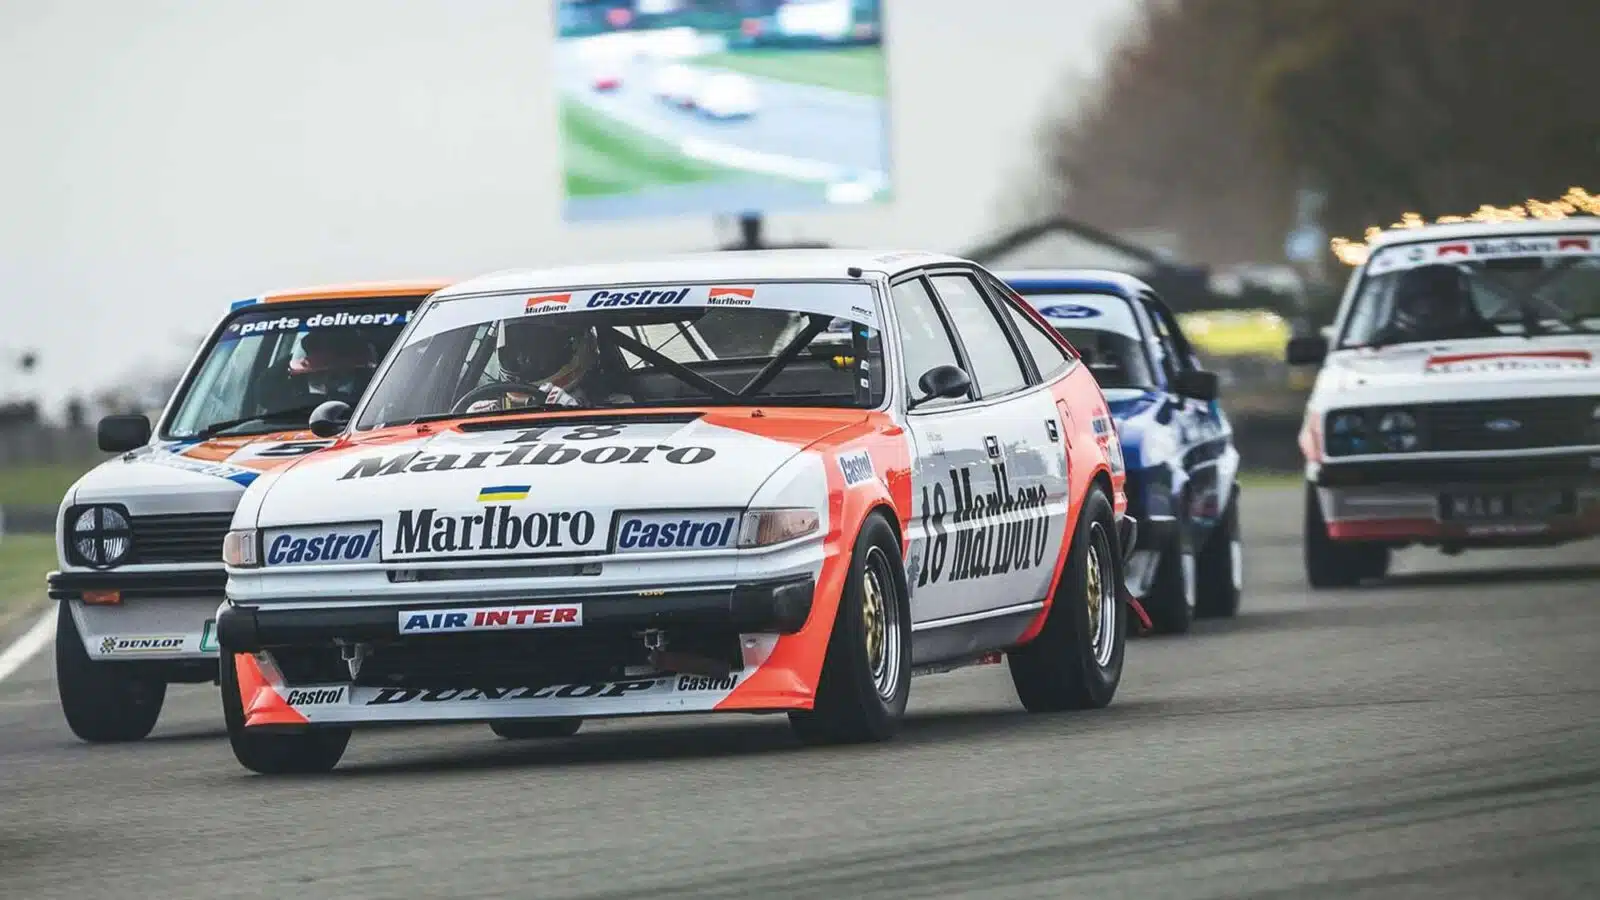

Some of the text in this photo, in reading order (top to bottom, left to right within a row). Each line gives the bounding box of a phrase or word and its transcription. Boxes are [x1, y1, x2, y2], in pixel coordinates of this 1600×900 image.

[524, 304, 567, 315] Marlboro
[586, 288, 691, 307] Castrol
[707, 296, 751, 306] Marlboro
[240, 316, 300, 336] parts
[306, 312, 400, 328] delivery
[503, 424, 628, 445] 18
[336, 443, 717, 481] Marlboro
[840, 451, 873, 485] Castrol
[392, 505, 596, 554] Marlboro
[618, 517, 736, 549] Castrol
[917, 463, 1050, 588] 18 Marlboro
[268, 529, 379, 565] Castrol
[403, 607, 578, 631] AIR INTER
[117, 639, 184, 648] DUNLOP
[677, 674, 738, 692] Castrol
[286, 687, 345, 706] Castrol
